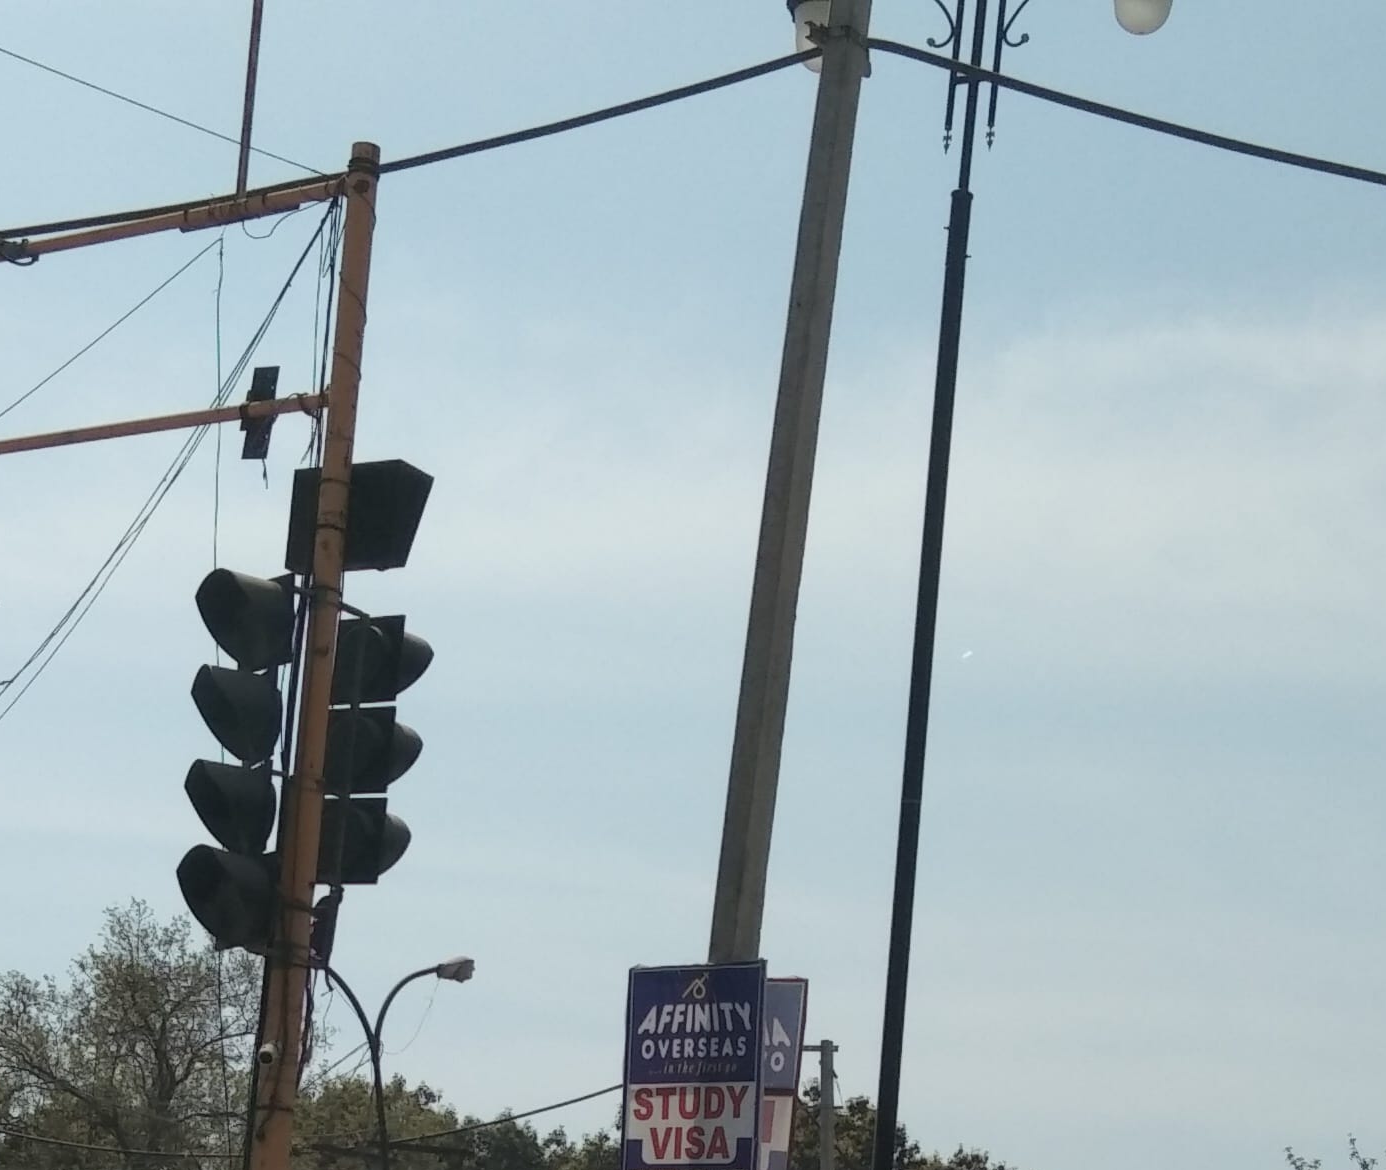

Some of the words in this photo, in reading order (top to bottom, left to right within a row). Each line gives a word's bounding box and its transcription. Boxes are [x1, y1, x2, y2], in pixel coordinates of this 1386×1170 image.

[637, 1002, 752, 1035] AFFINITY
[641, 1036, 747, 1060] OVERSEAS
[633, 1085, 749, 1121] STUDY
[650, 1126, 730, 1160] VISA
